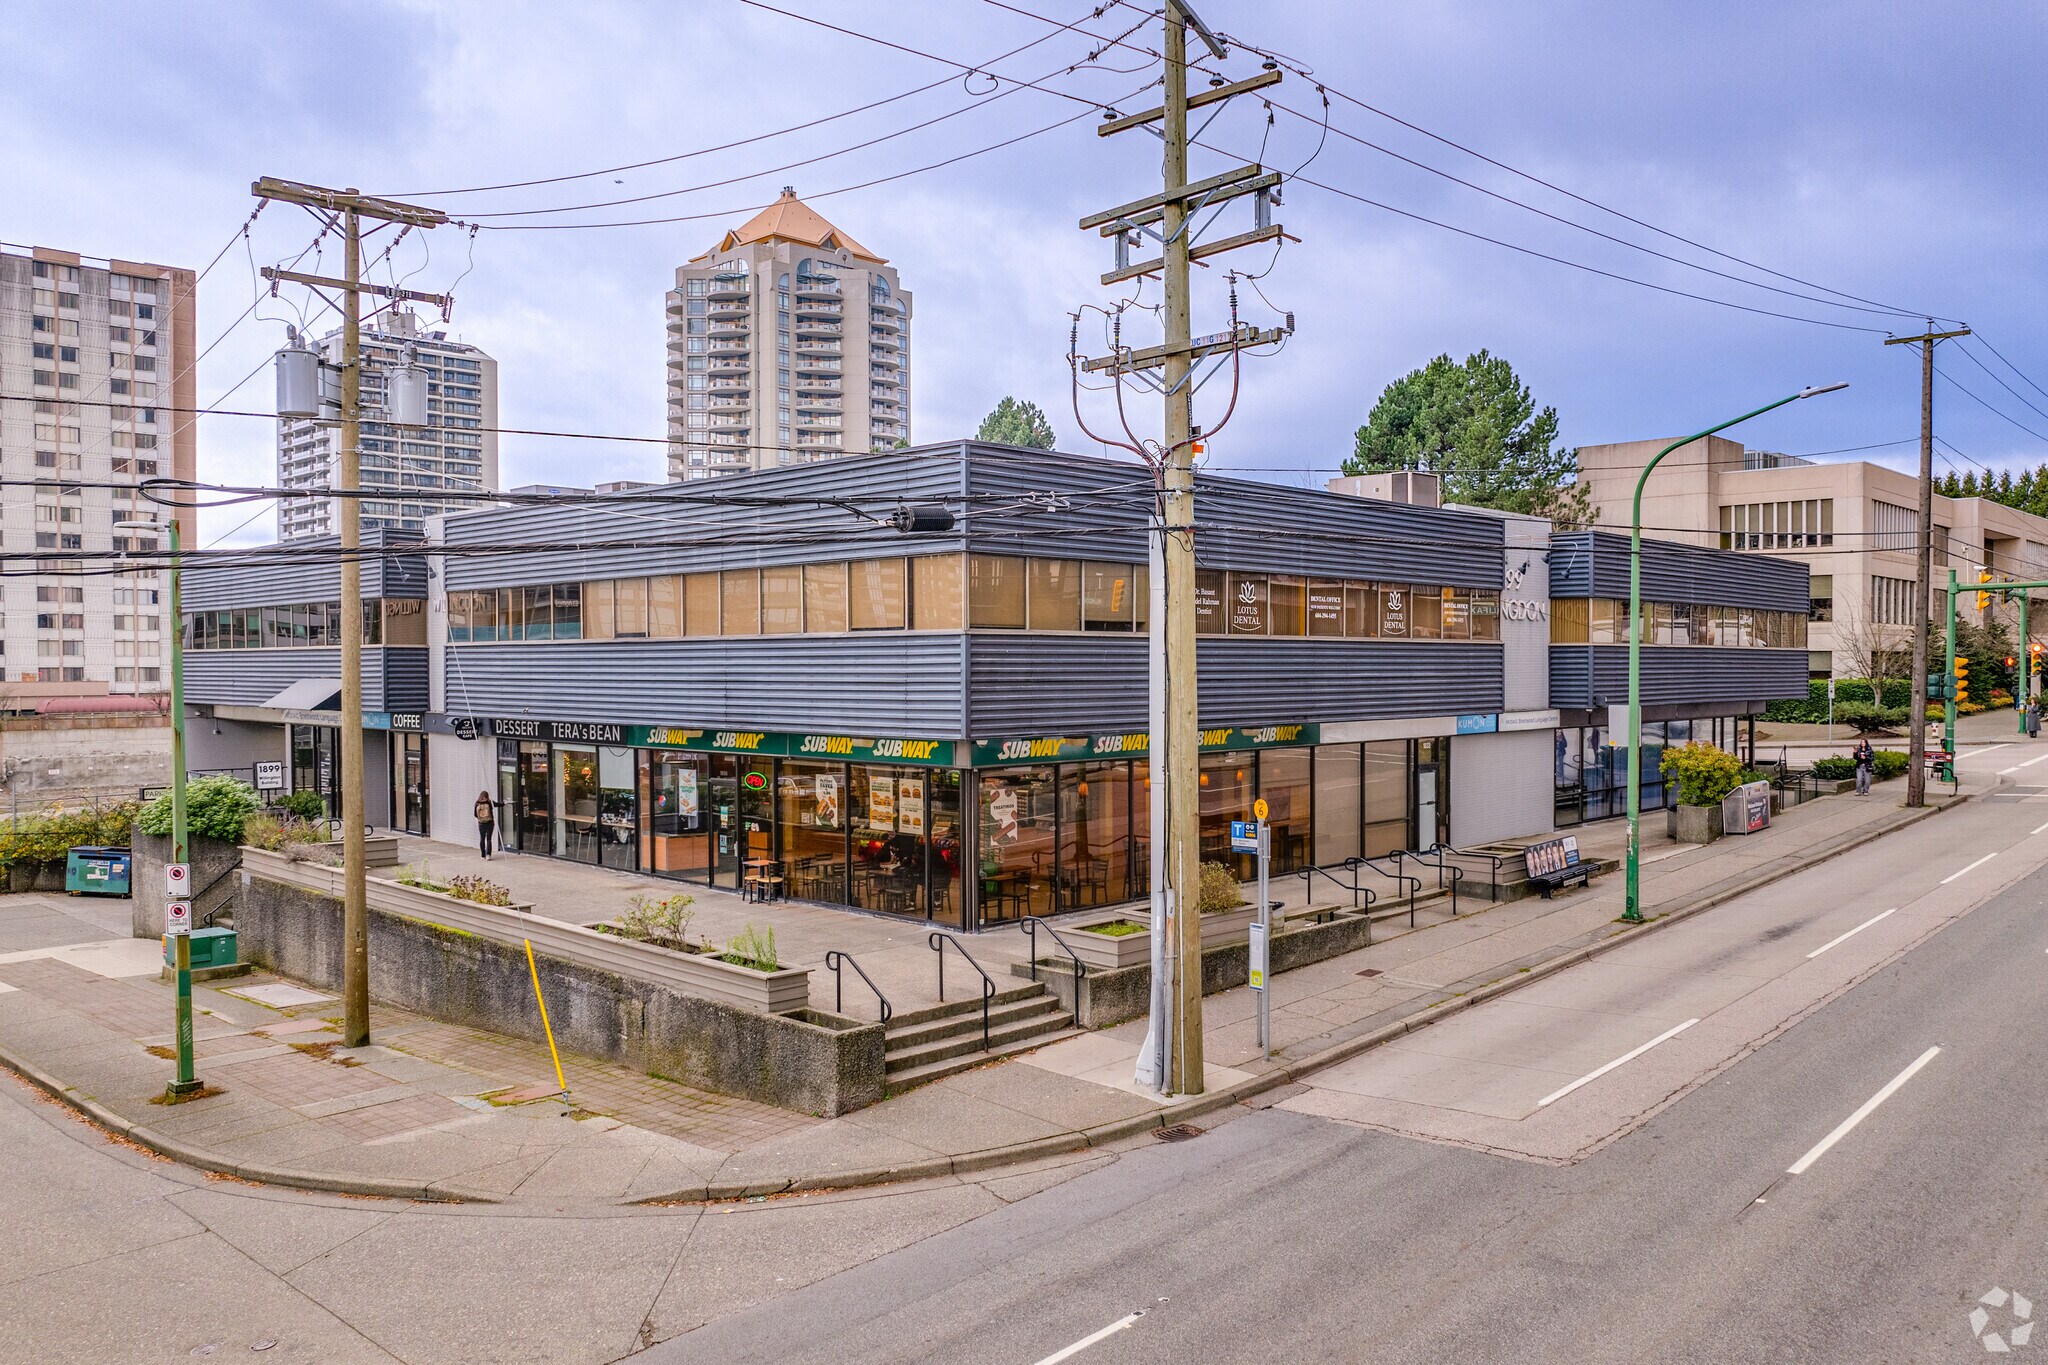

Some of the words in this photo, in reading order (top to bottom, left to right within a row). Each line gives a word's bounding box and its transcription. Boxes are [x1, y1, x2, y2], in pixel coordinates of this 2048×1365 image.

[1310, 595, 1327, 603] DENTAL
[1237, 606, 1257, 615] LOTUS
[1387, 612, 1403, 620] LOTUS
[1234, 616, 1260, 625] DENTAL
[1384, 621, 1406, 630] DENTAL
[393, 714, 420, 728] COFFEE
[1458, 716, 1485, 729] KUMON
[495, 719, 540, 737] DESSERT
[551, 722, 588, 740] TERA's
[589, 724, 621, 742] BEAN
[647, 728, 689, 745] SUBWAY
[1253, 725, 1302, 743] SUBWAY
[712, 731, 765, 749] SUBWAY
[800, 735, 854, 755] SUBWAY
[873, 739, 939, 760] SUBWAY
[997, 737, 1067, 761] SUBWAY
[259, 765, 280, 773] 1899
[746, 774, 764, 787] OPEN
[1259, 806, 1264, 816] 6
